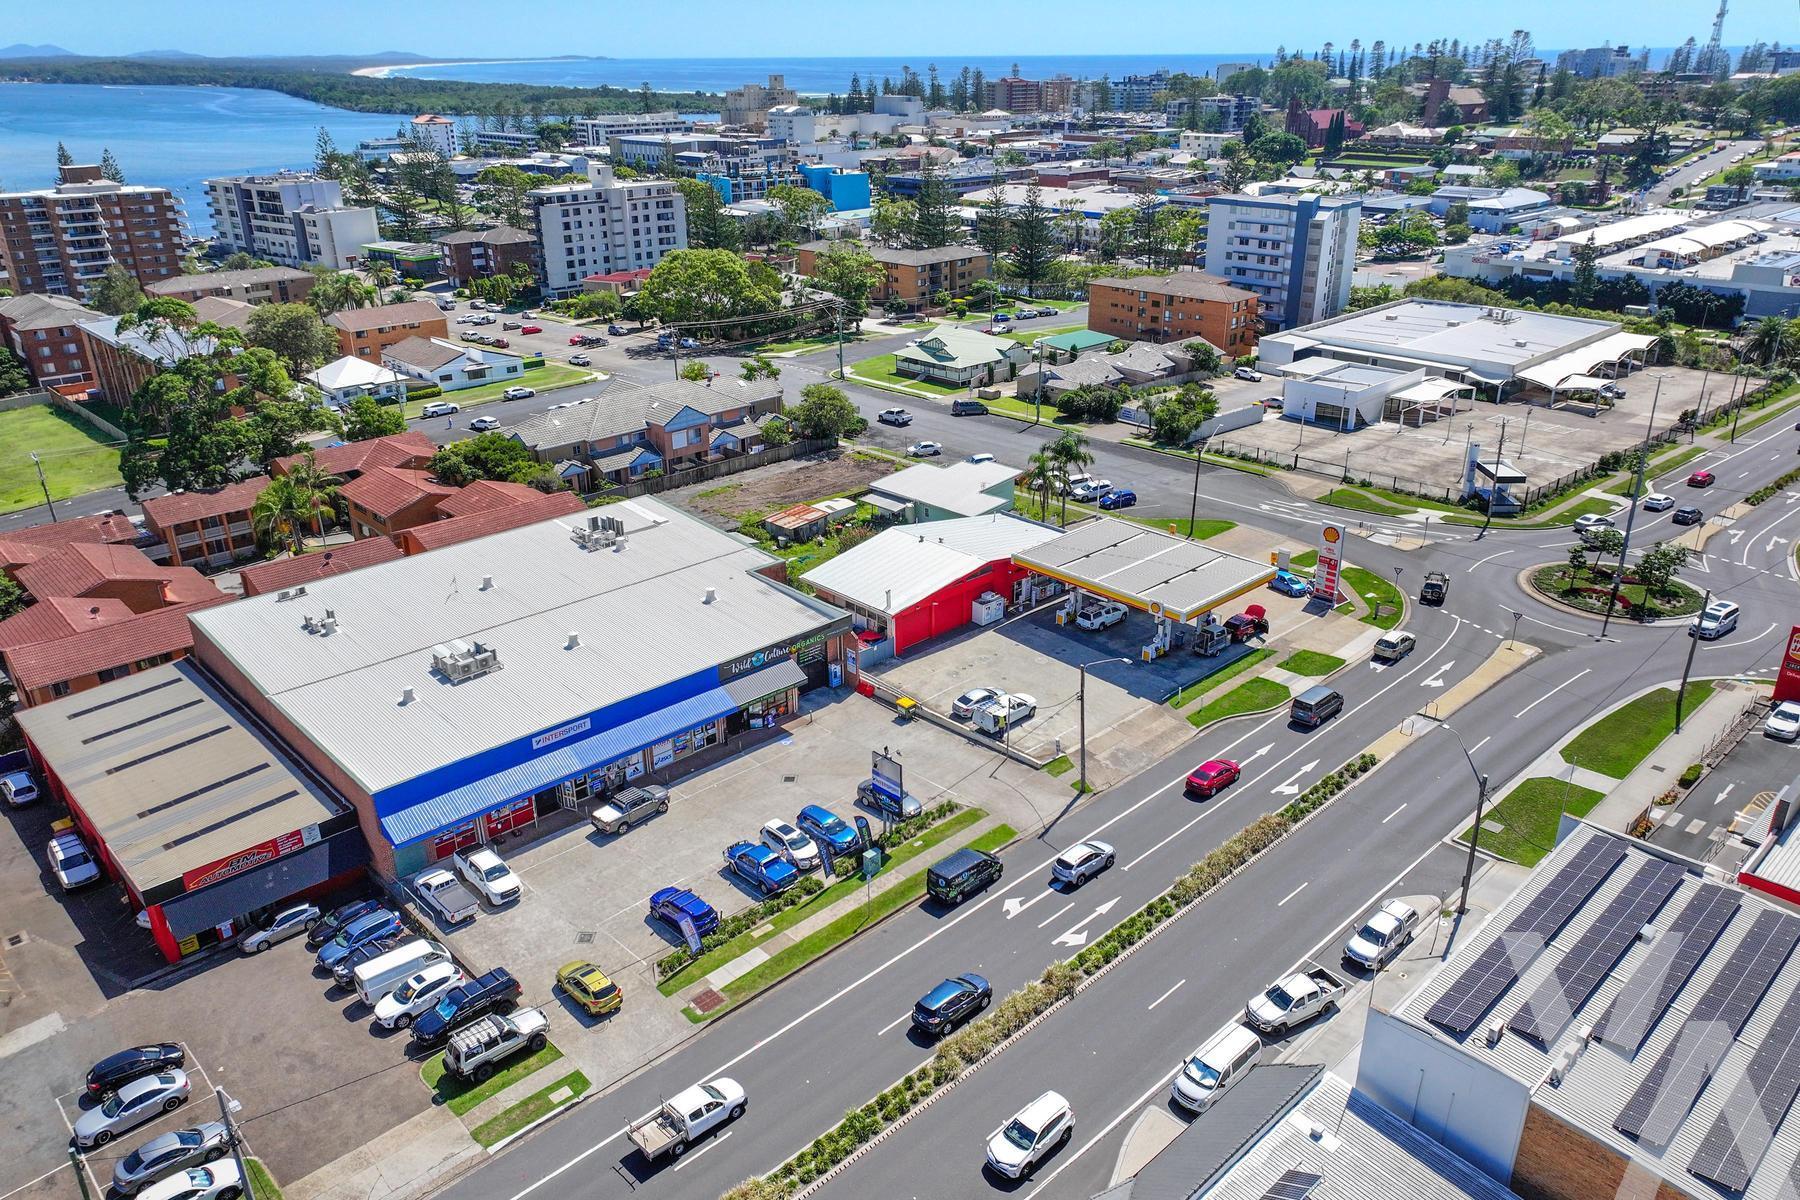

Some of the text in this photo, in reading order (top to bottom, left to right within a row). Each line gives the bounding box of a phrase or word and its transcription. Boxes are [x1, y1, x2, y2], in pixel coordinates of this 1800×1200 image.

[723, 660, 752, 674] Wild
[764, 646, 790, 662] Culture
[791, 634, 825, 650] ORGANICS
[541, 721, 588, 744] INTERSPORT
[200, 852, 273, 885] AUTOMOTIVE
[228, 851, 258, 868] BM
